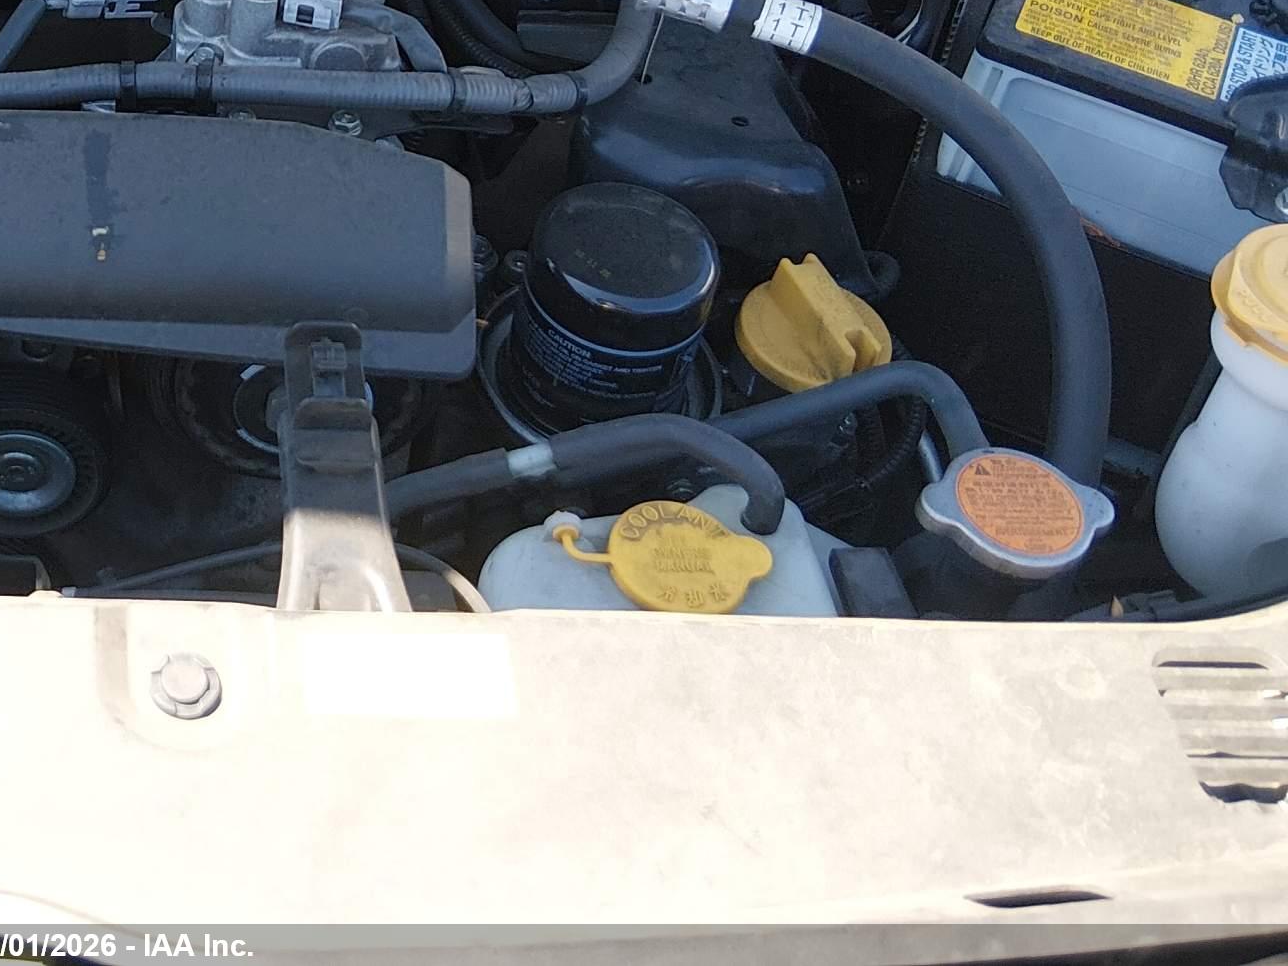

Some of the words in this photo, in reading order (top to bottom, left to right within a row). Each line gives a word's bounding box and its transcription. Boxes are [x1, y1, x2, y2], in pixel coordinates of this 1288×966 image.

[1029, 0, 1083, 24] POISON
[1065, 1, 1086, 13] VENT
[1087, 9, 1111, 22] CAPS
[1029, 26, 1051, 39] KEEP
[1052, 33, 1069, 45] OUT
[1238, 31, 1258, 57] START
[1230, 63, 1248, 84] STOP
[1201, 76, 1220, 96] CCA
[548, 329, 592, 359] CAUTION
[620, 505, 728, 540] COOLANT
